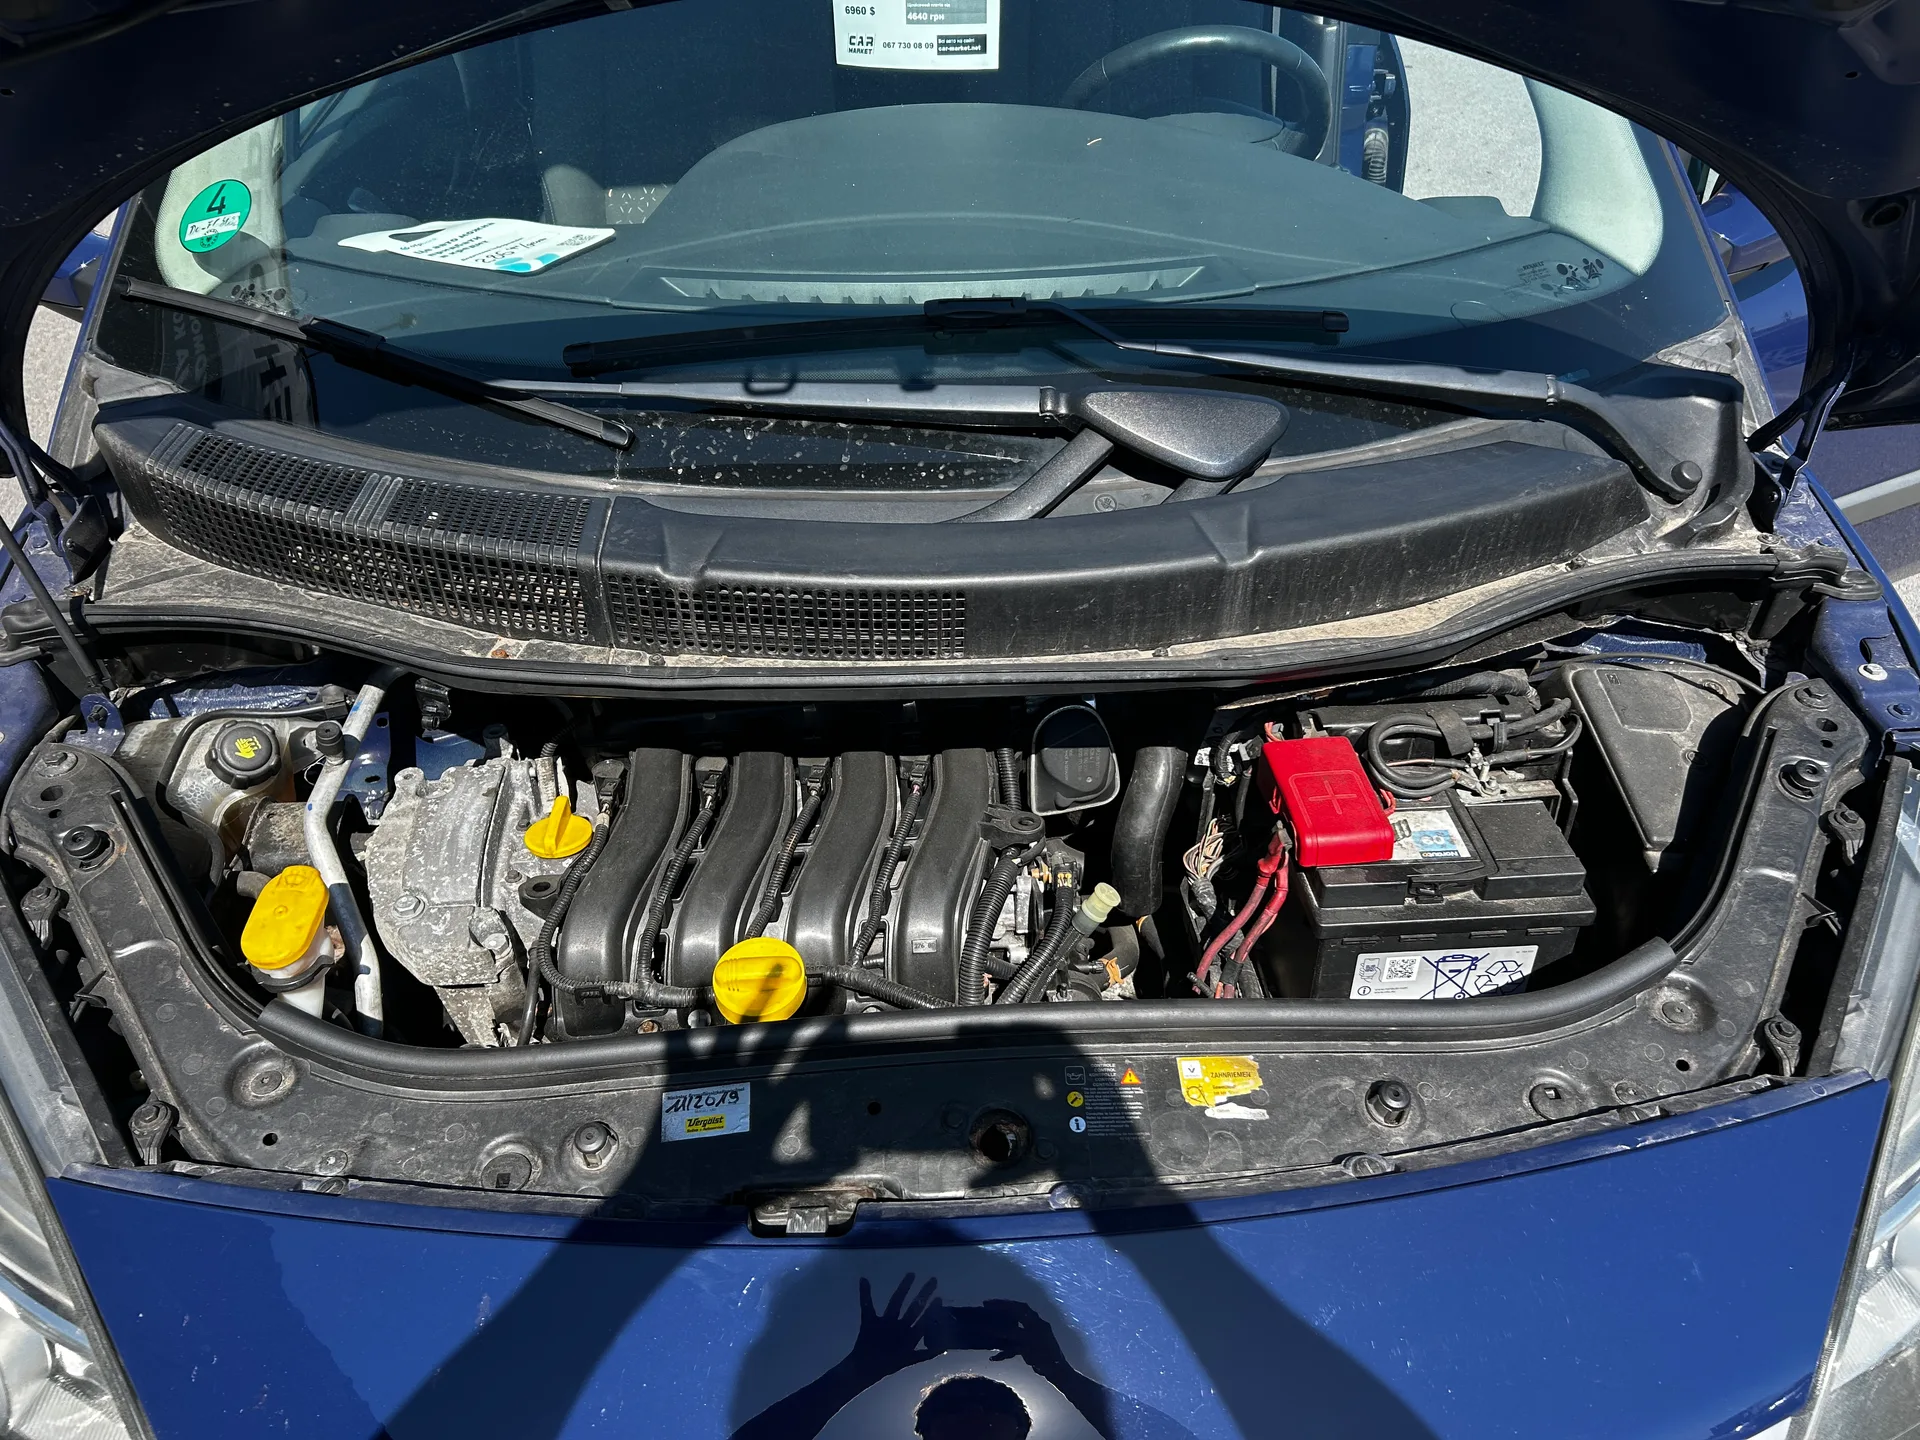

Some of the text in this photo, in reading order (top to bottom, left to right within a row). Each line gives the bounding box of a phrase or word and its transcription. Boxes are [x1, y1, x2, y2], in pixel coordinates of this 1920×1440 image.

[845, 5, 876, 16] 6960 $
[907, 12, 945, 22] 4640 грн
[849, 35, 874, 47] CAR
[848, 47, 873, 55] MARKET
[938, 44, 981, 52] car-market.net
[205, 183, 227, 215] 4
[1422, 850, 1459, 858] Norauto
[687, 1115, 724, 1127] Vergölst
